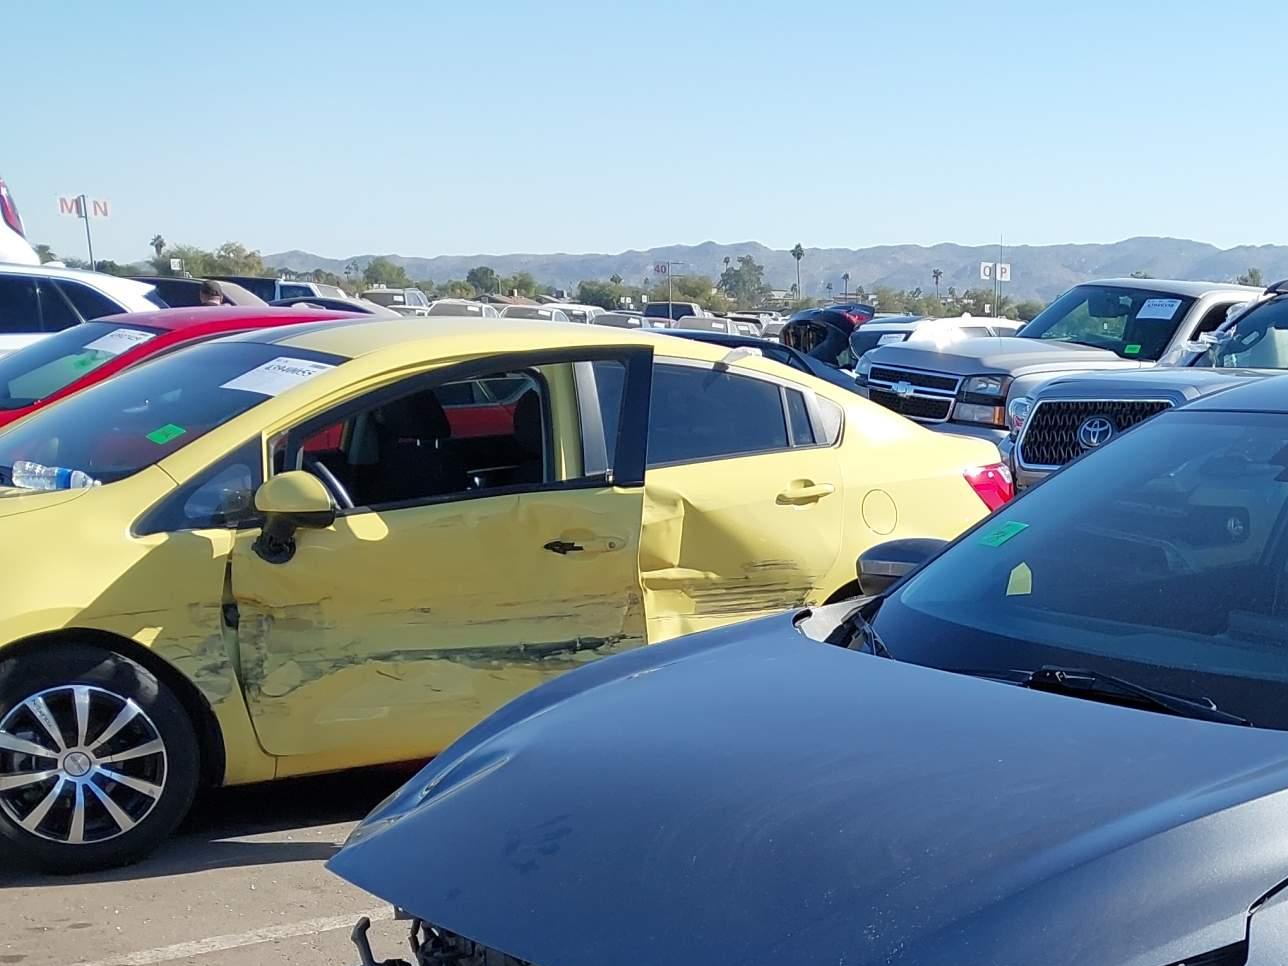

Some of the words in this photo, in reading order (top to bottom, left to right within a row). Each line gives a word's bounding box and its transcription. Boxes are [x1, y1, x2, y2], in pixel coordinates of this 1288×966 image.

[59, 197, 79, 215] M
[93, 200, 108, 217] N
[654, 264, 667, 274] 40
[983, 265, 992, 277] O
[1000, 267, 1007, 278] P
